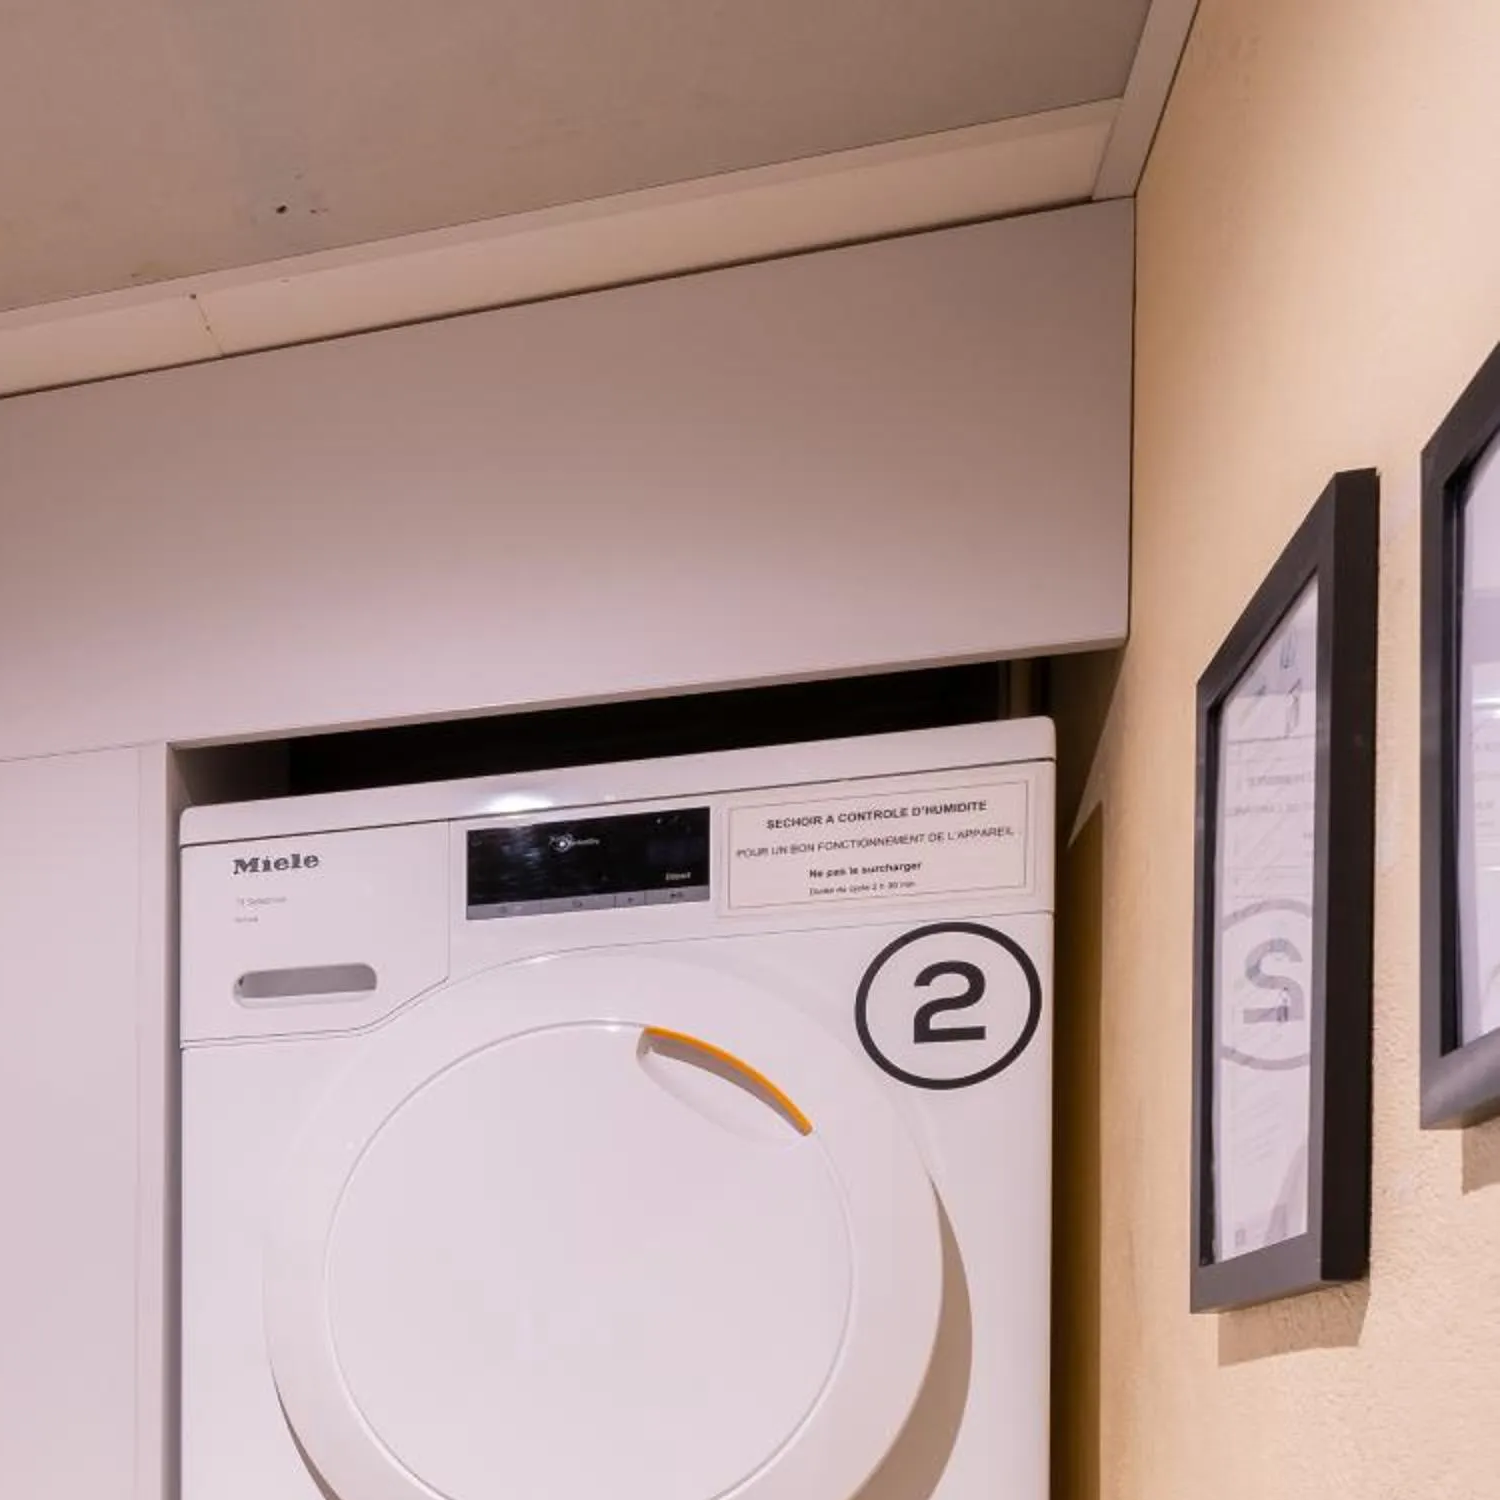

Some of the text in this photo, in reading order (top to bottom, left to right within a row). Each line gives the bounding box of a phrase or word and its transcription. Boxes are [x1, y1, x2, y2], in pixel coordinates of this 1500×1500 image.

[766, 800, 988, 830] SECHOIR A CONTROLE D'HUMIDITE
[735, 847, 769, 858] POUR
[771, 846, 788, 857] UN
[789, 843, 815, 855] BON
[817, 833, 925, 853] FONCTIONNEMENT
[928, 831, 944, 843] DE
[232, 853, 320, 875] Miele
[809, 869, 823, 878] Ne
[861, 861, 922, 874] surcharger
[913, 960, 987, 1044] 2
